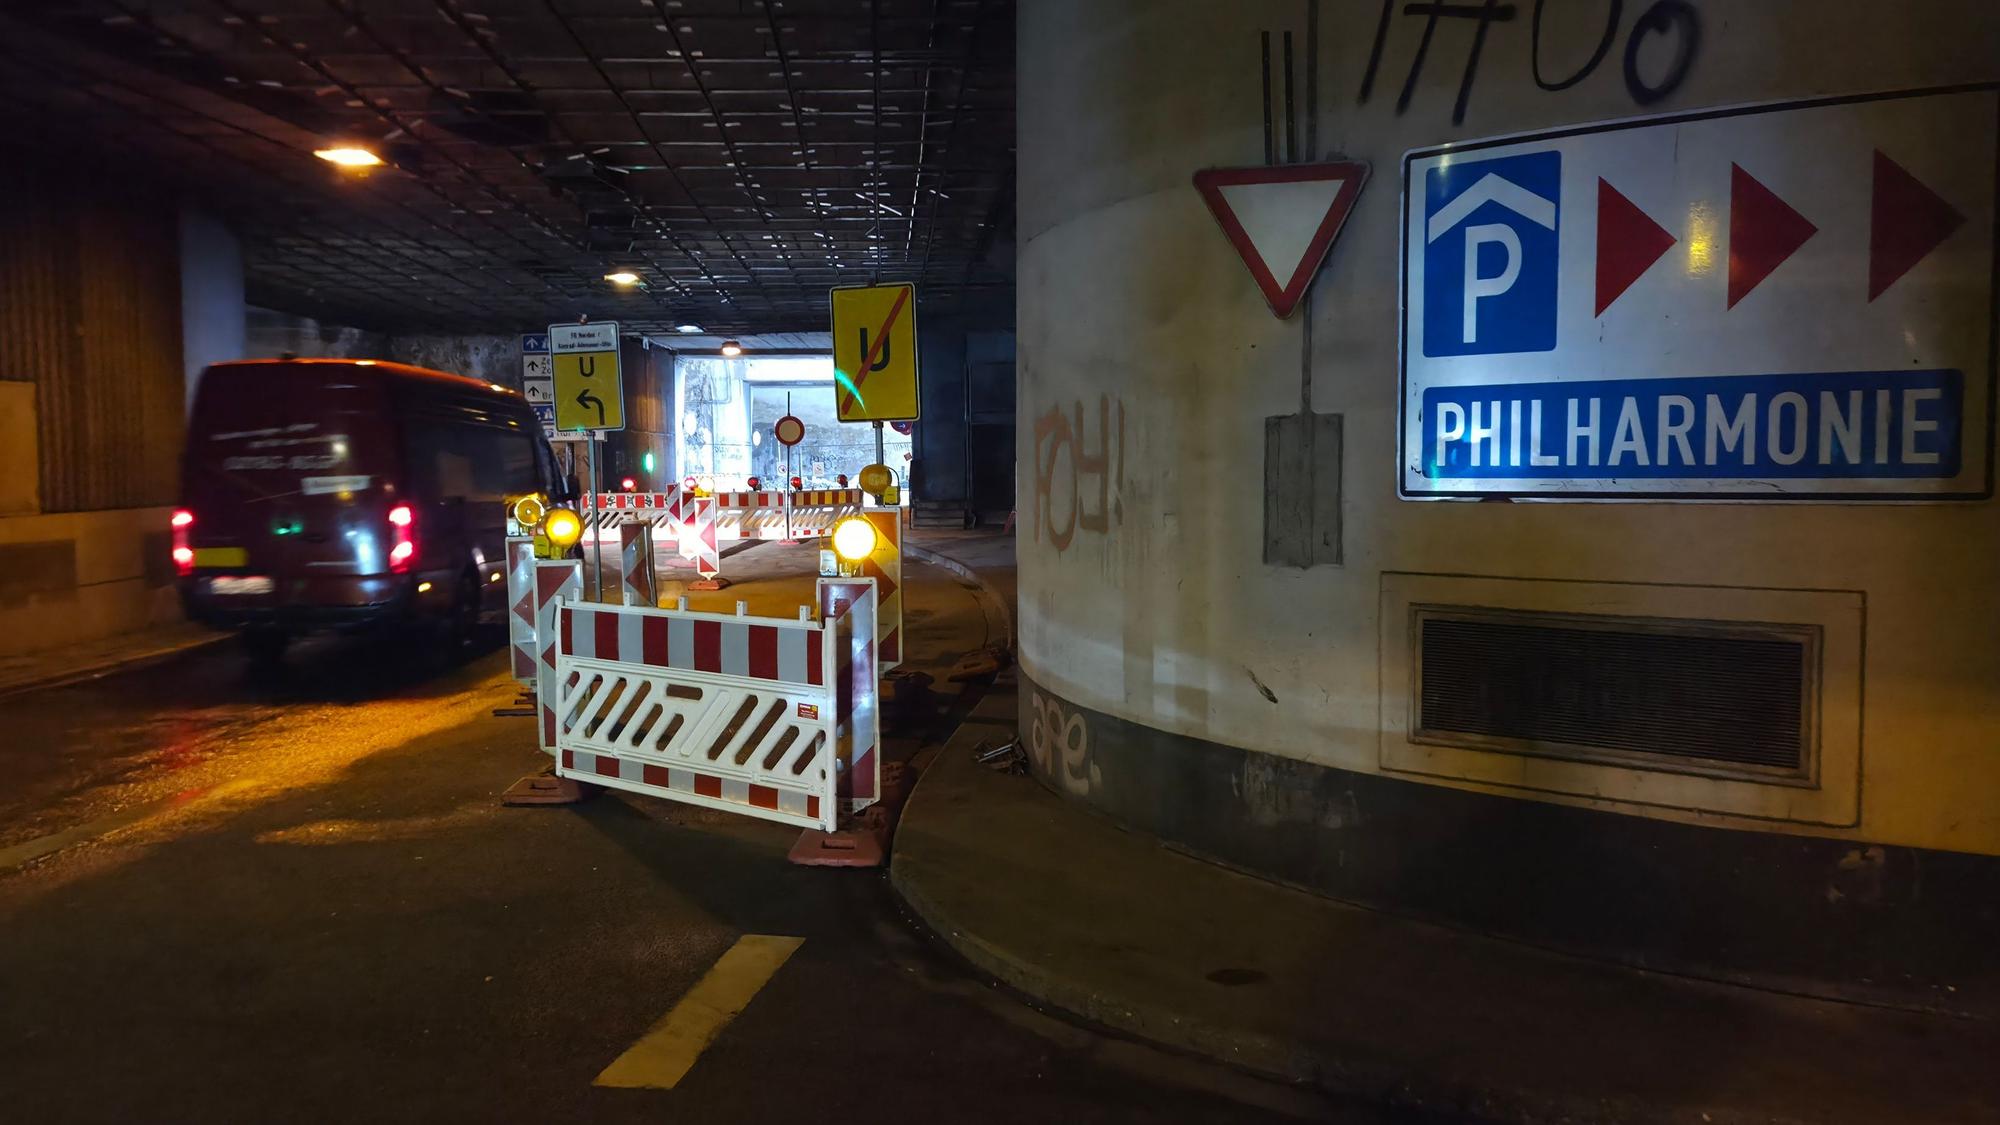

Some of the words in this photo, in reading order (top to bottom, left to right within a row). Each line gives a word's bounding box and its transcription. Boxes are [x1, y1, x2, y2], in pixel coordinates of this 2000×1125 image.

[1463, 223, 1522, 343] P
[579, 356, 595, 377] U
[860, 327, 891, 372] U
[1436, 388, 1941, 467] PHILHARMONIE
